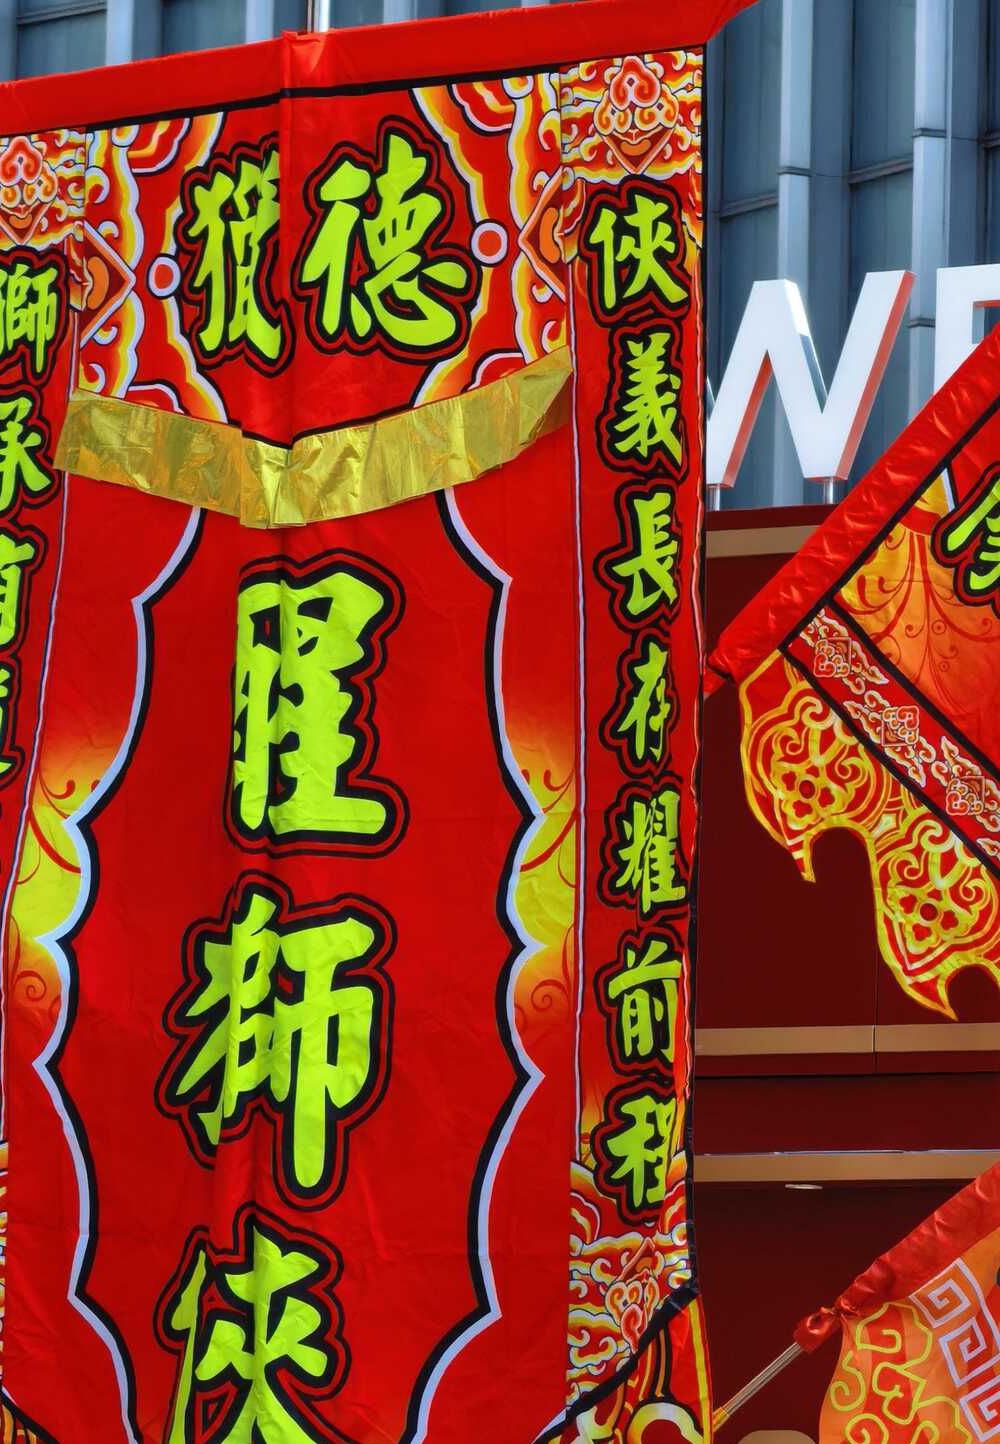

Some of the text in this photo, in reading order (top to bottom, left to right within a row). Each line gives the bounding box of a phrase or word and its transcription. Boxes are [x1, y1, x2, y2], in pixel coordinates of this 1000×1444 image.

[189, 134, 470, 361] 獵德
[589, 197, 689, 1208] 俠義長存耀前程
